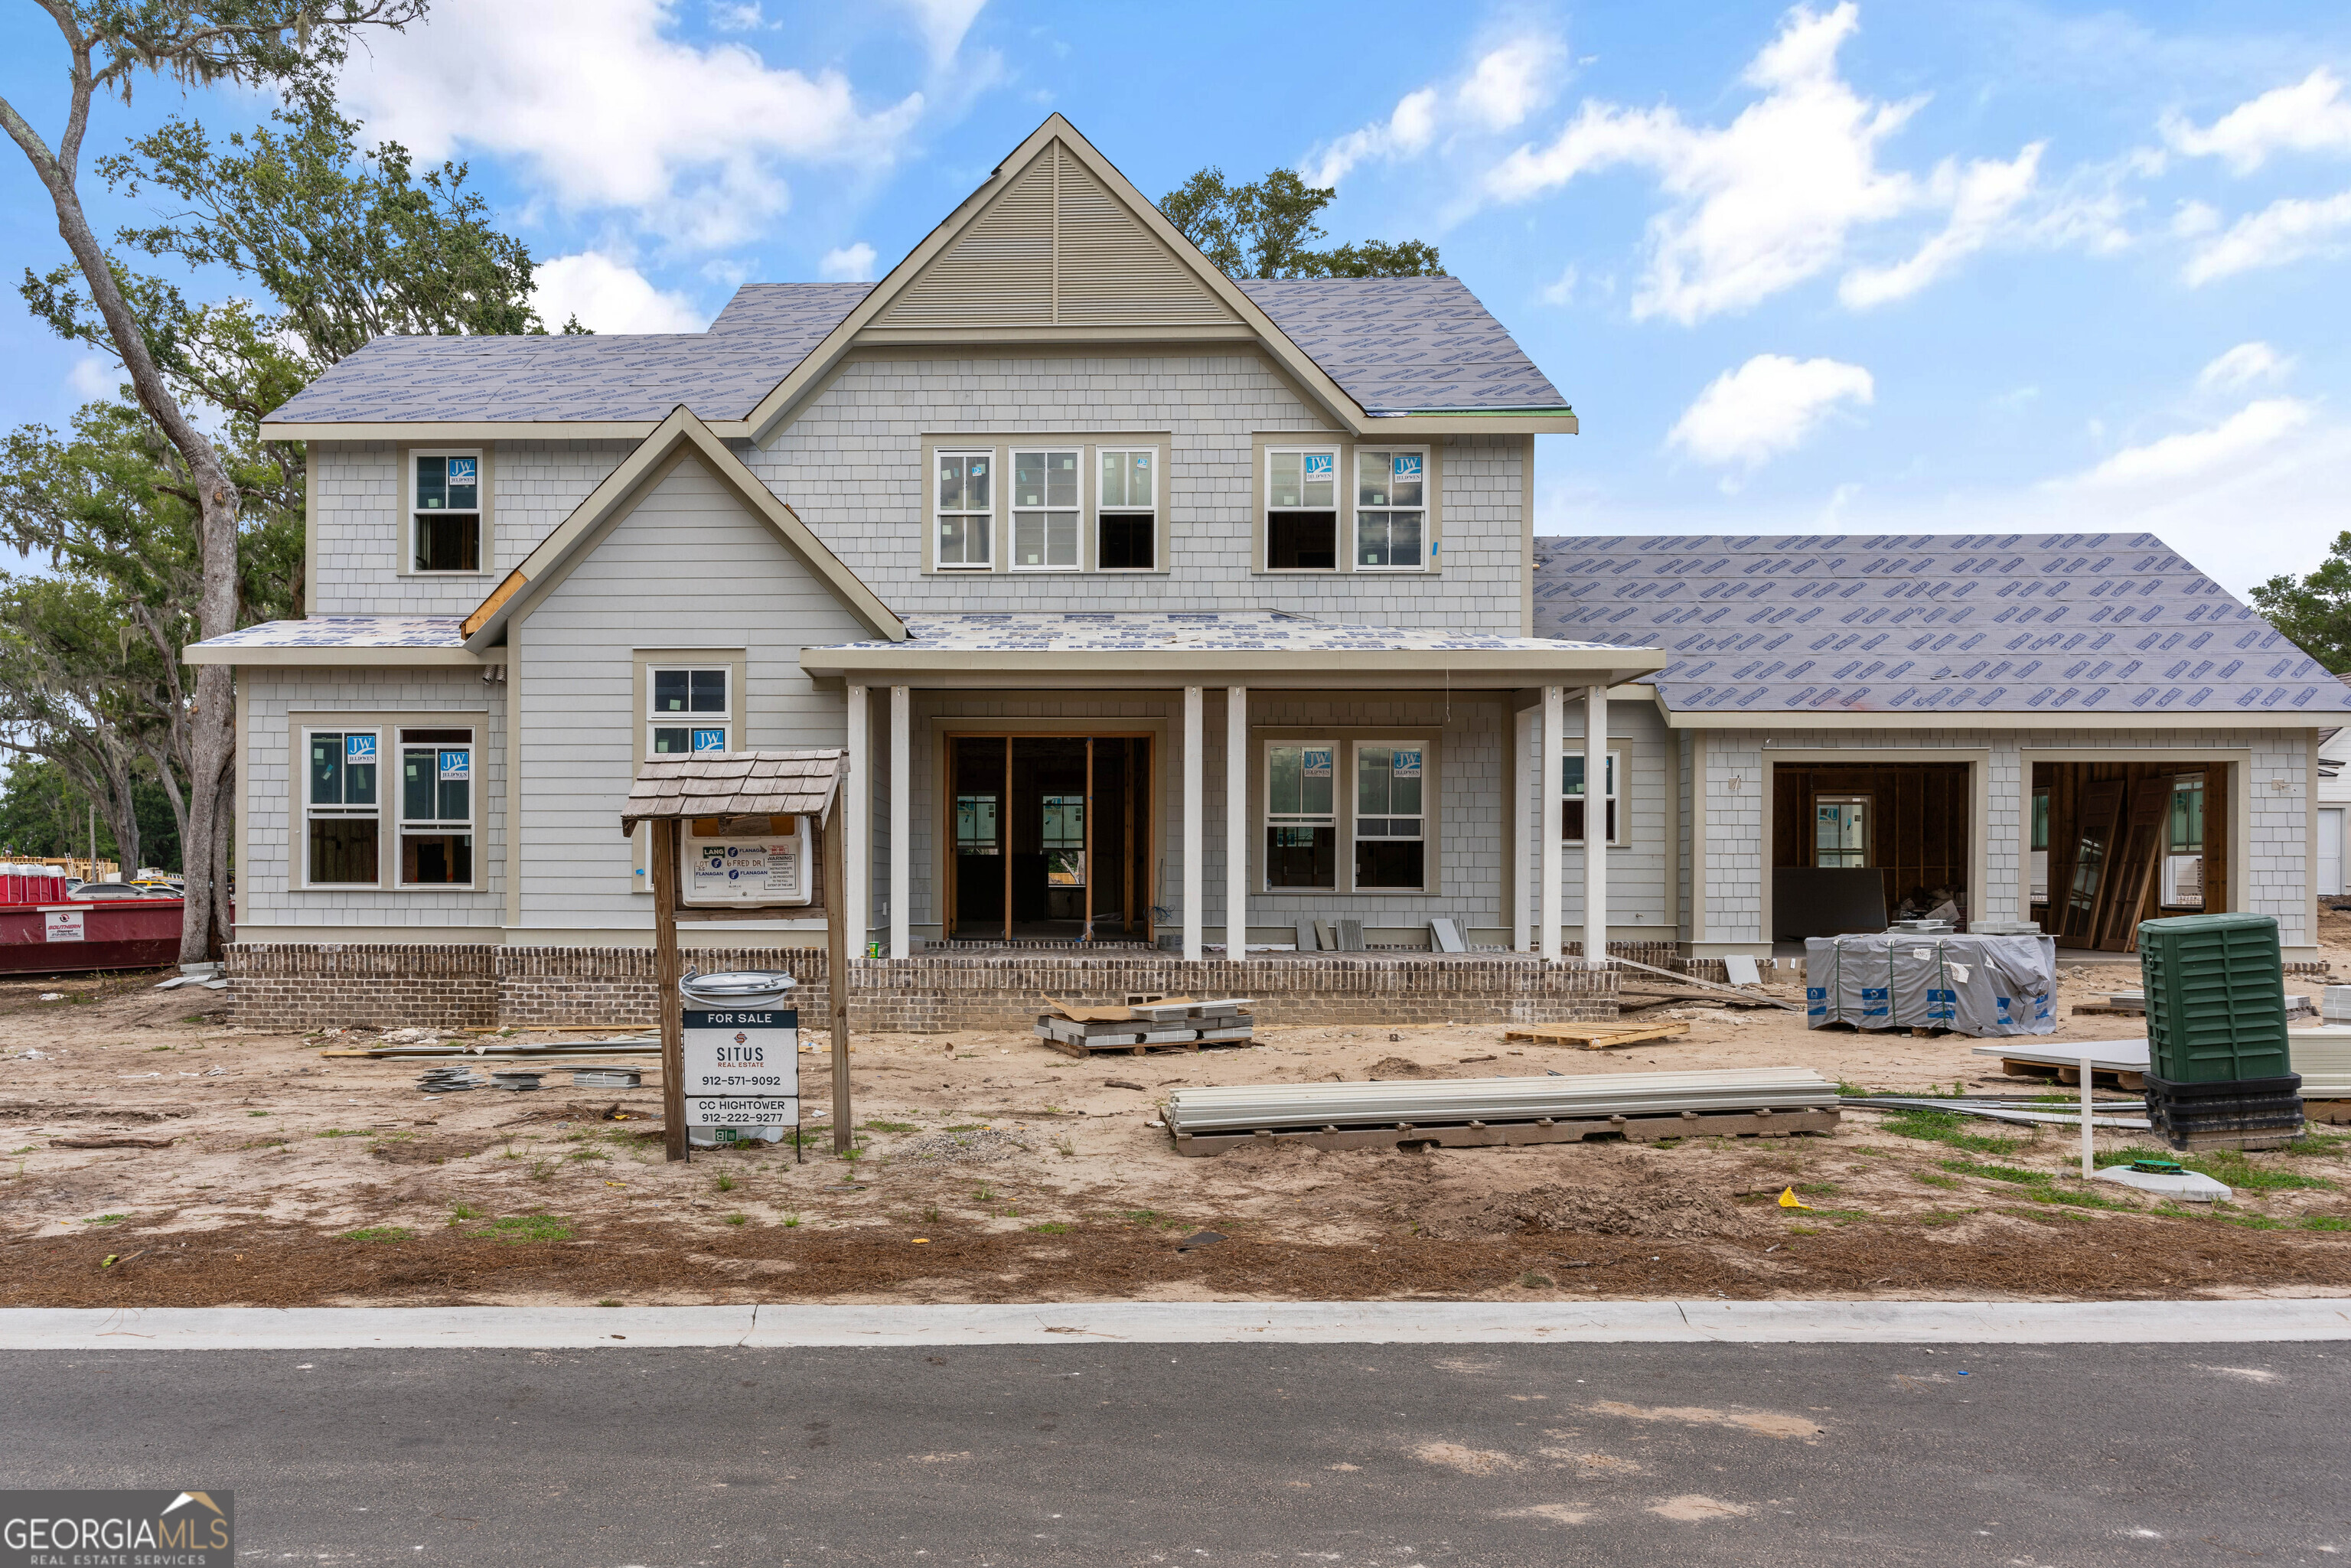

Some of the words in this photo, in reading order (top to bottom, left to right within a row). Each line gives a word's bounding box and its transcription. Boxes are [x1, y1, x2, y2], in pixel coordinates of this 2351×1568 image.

[452, 461, 471, 474] JW
[1309, 457, 1329, 471] JW
[1397, 458, 1417, 473] JW
[351, 738, 372, 753] JW
[698, 732, 719, 748] JW
[443, 754, 465, 769] JW
[708, 1014, 732, 1023] FOR
[738, 1014, 772, 1023] SALE
[717, 1047, 764, 1061] SITUS
[703, 1077, 781, 1085] 912-571-9092
[699, 1101, 716, 1110] CC
[719, 1101, 785, 1110] HIGHTOWER
[702, 1113, 783, 1122] 912-222-9277
